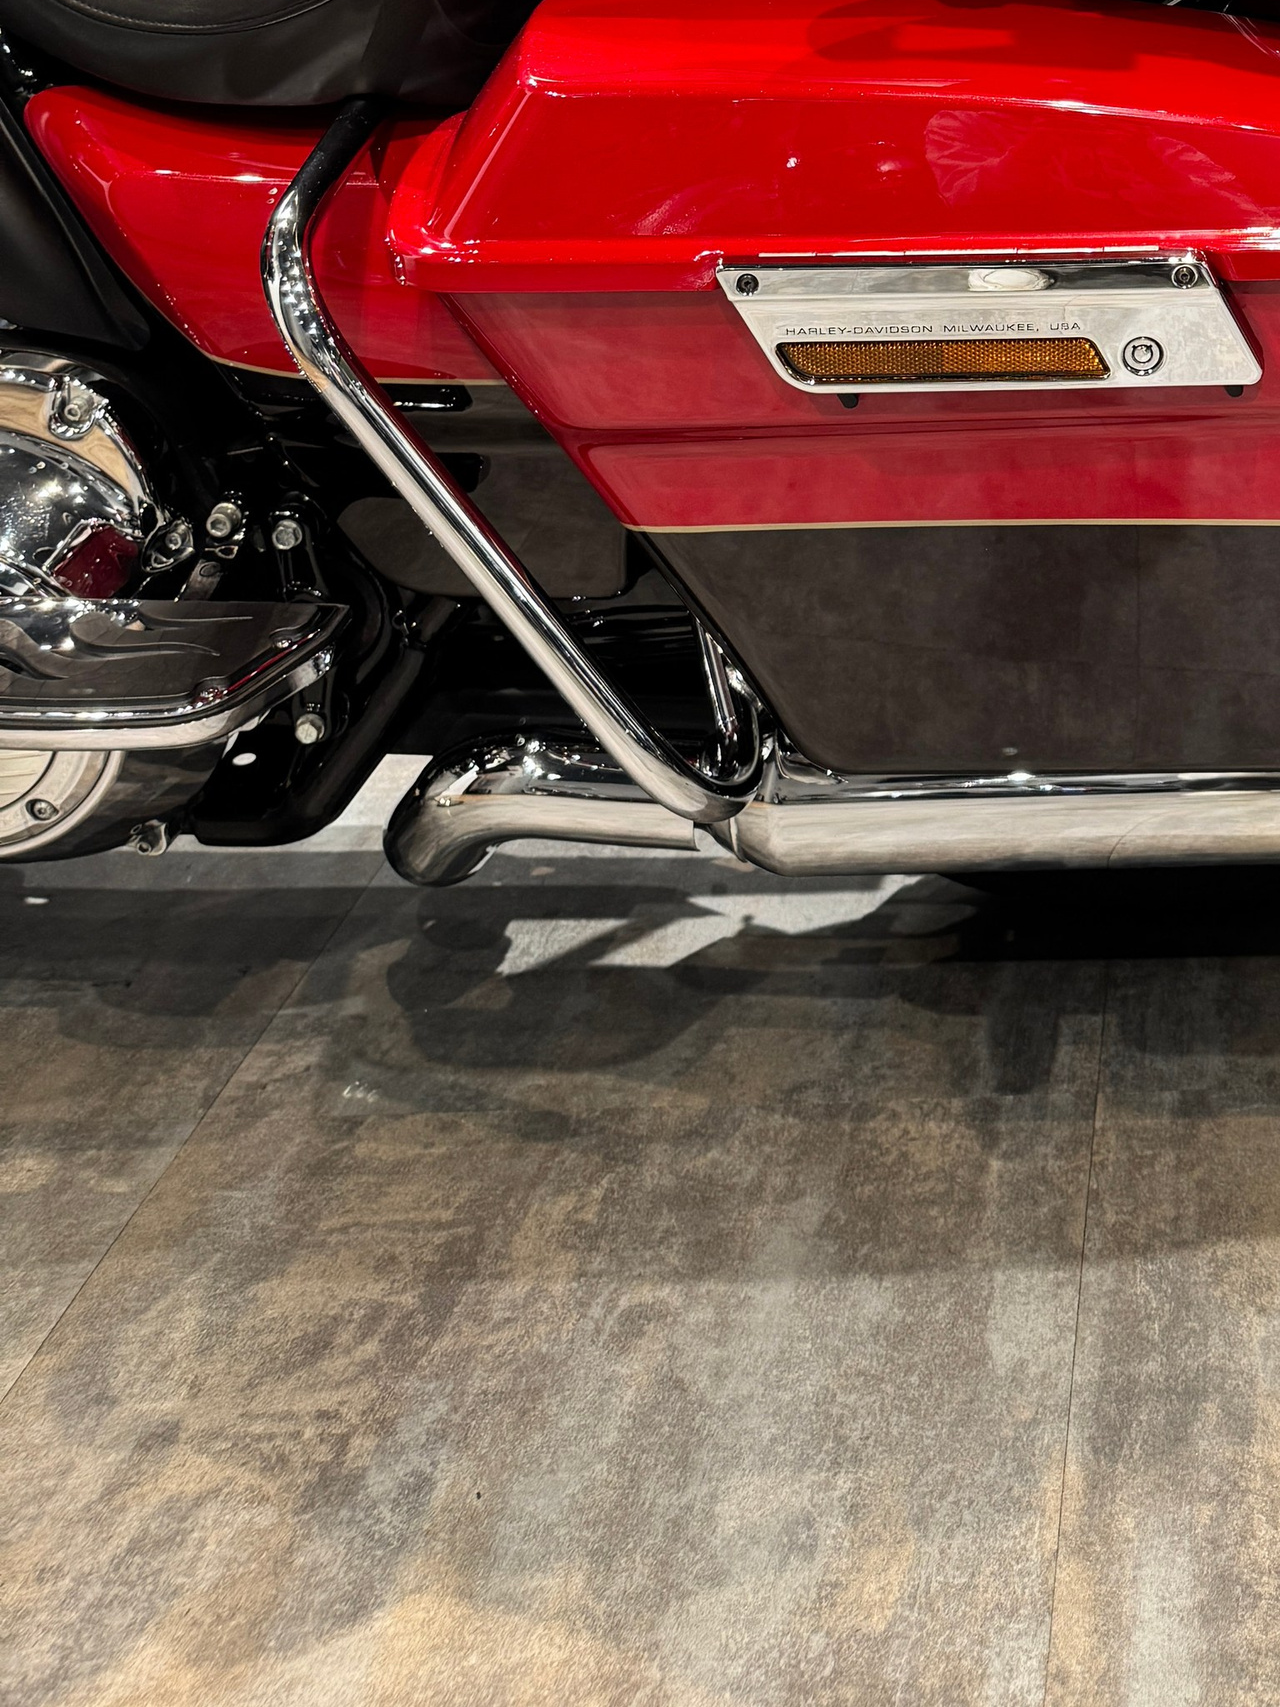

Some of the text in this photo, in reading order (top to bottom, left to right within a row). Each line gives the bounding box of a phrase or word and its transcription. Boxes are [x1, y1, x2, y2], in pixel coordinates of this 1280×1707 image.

[785, 322, 1081, 336] HARLEY-DAVIDSON MILWAUKEE, USA
